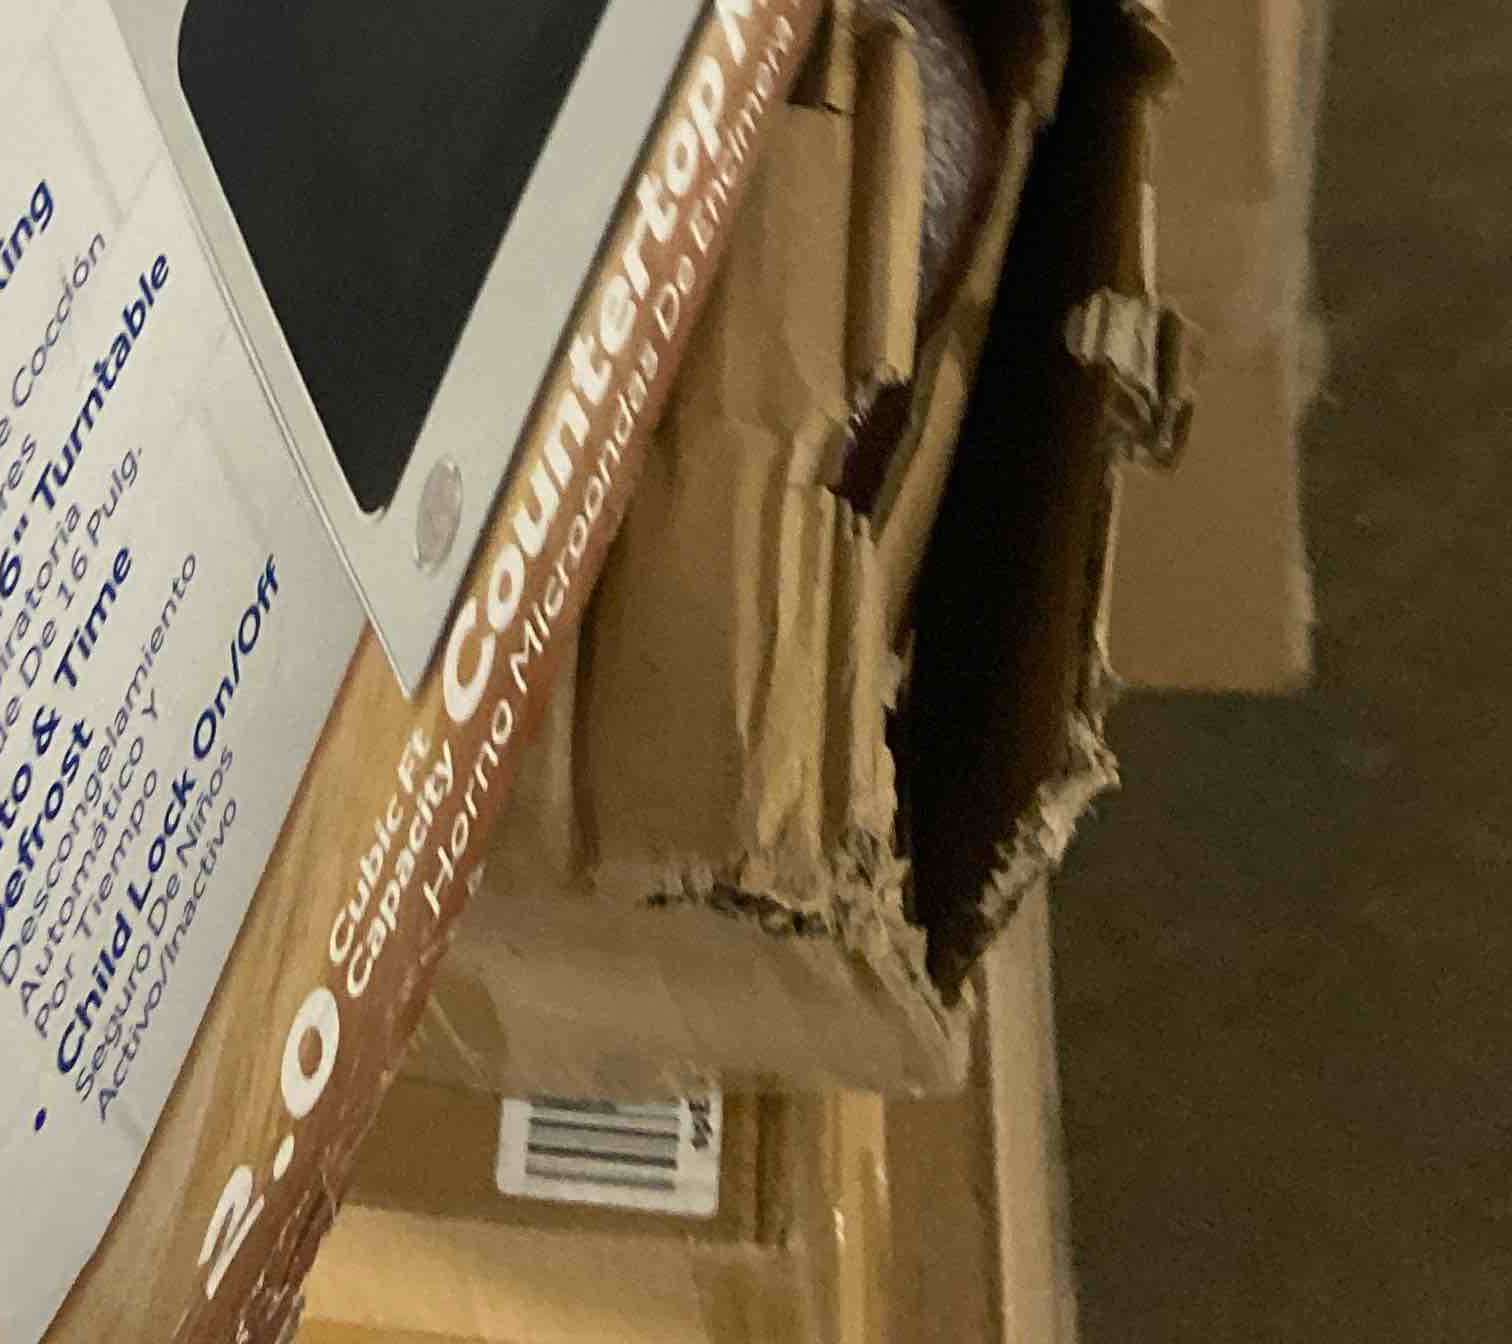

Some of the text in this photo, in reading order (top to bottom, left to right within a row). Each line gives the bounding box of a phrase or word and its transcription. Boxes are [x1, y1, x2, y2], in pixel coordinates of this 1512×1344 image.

[11, 233, 105, 407] Cocción
[31, 255, 168, 508] Turntable
[441, 58, 727, 724] Countertop
[18, 619, 56, 688] De
[56, 546, 88, 609] 16
[85, 447, 141, 546] Pulg.
[31, 705, 60, 756] &
[53, 547, 131, 687] Time
[422, 698, 515, 917] Horno
[516, 343, 660, 698] Microondas
[653, 261, 697, 343] De
[20, 687, 158, 1014] Automático Y
[33, 769, 157, 1038] Por Tiempo
[56, 554, 278, 1073] Child Lock On/Off
[74, 746, 233, 1101] Seguro De Niños
[329, 724, 432, 968] Cubic Ft
[345, 739, 455, 999] Capacity
[98, 799, 236, 1121] Activo/Inactivo
[197, 986, 341, 1300] 2.0
